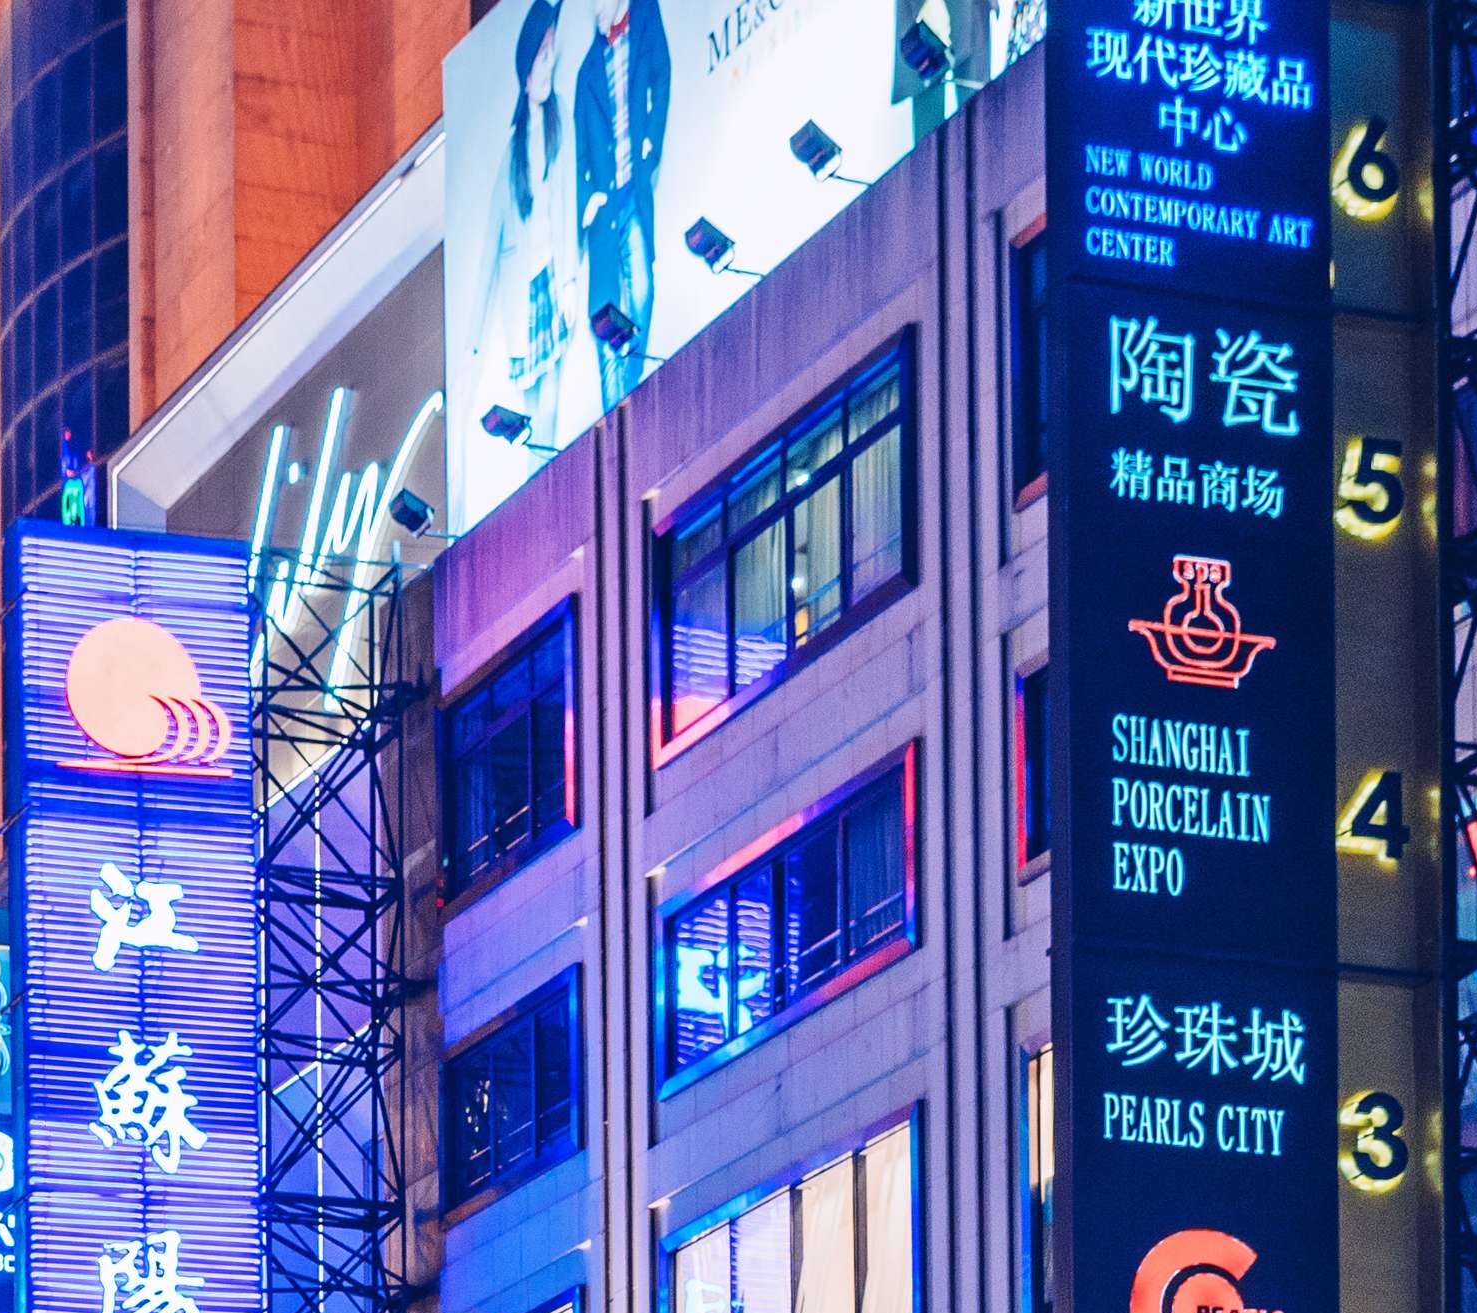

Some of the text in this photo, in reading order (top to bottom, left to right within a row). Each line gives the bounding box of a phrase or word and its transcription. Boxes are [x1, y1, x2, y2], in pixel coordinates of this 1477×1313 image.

[1086, 27, 1313, 110] 现代珍藏品
[1159, 97, 1246, 153] 中心
[1085, 145, 1213, 190] NEW WORLD
[1348, 116, 1400, 204] 6
[1085, 186, 1314, 249] CONTEMPORARY ART
[1085, 230, 1176, 267] CENTER
[1109, 314, 1300, 436] 陶瓷
[1110, 446, 1286, 519] 精品商场
[1351, 437, 1404, 524] 5
[1111, 713, 1251, 777] SHANGHAI
[1111, 777, 1271, 843] PORCELAIN
[1350, 771, 1410, 859] 4
[1112, 843, 1185, 897] EXPO
[1106, 994, 1307, 1085] 珍珠城
[1103, 1091, 1285, 1157] PEARLS CITY
[1351, 1091, 1409, 1180] 3
